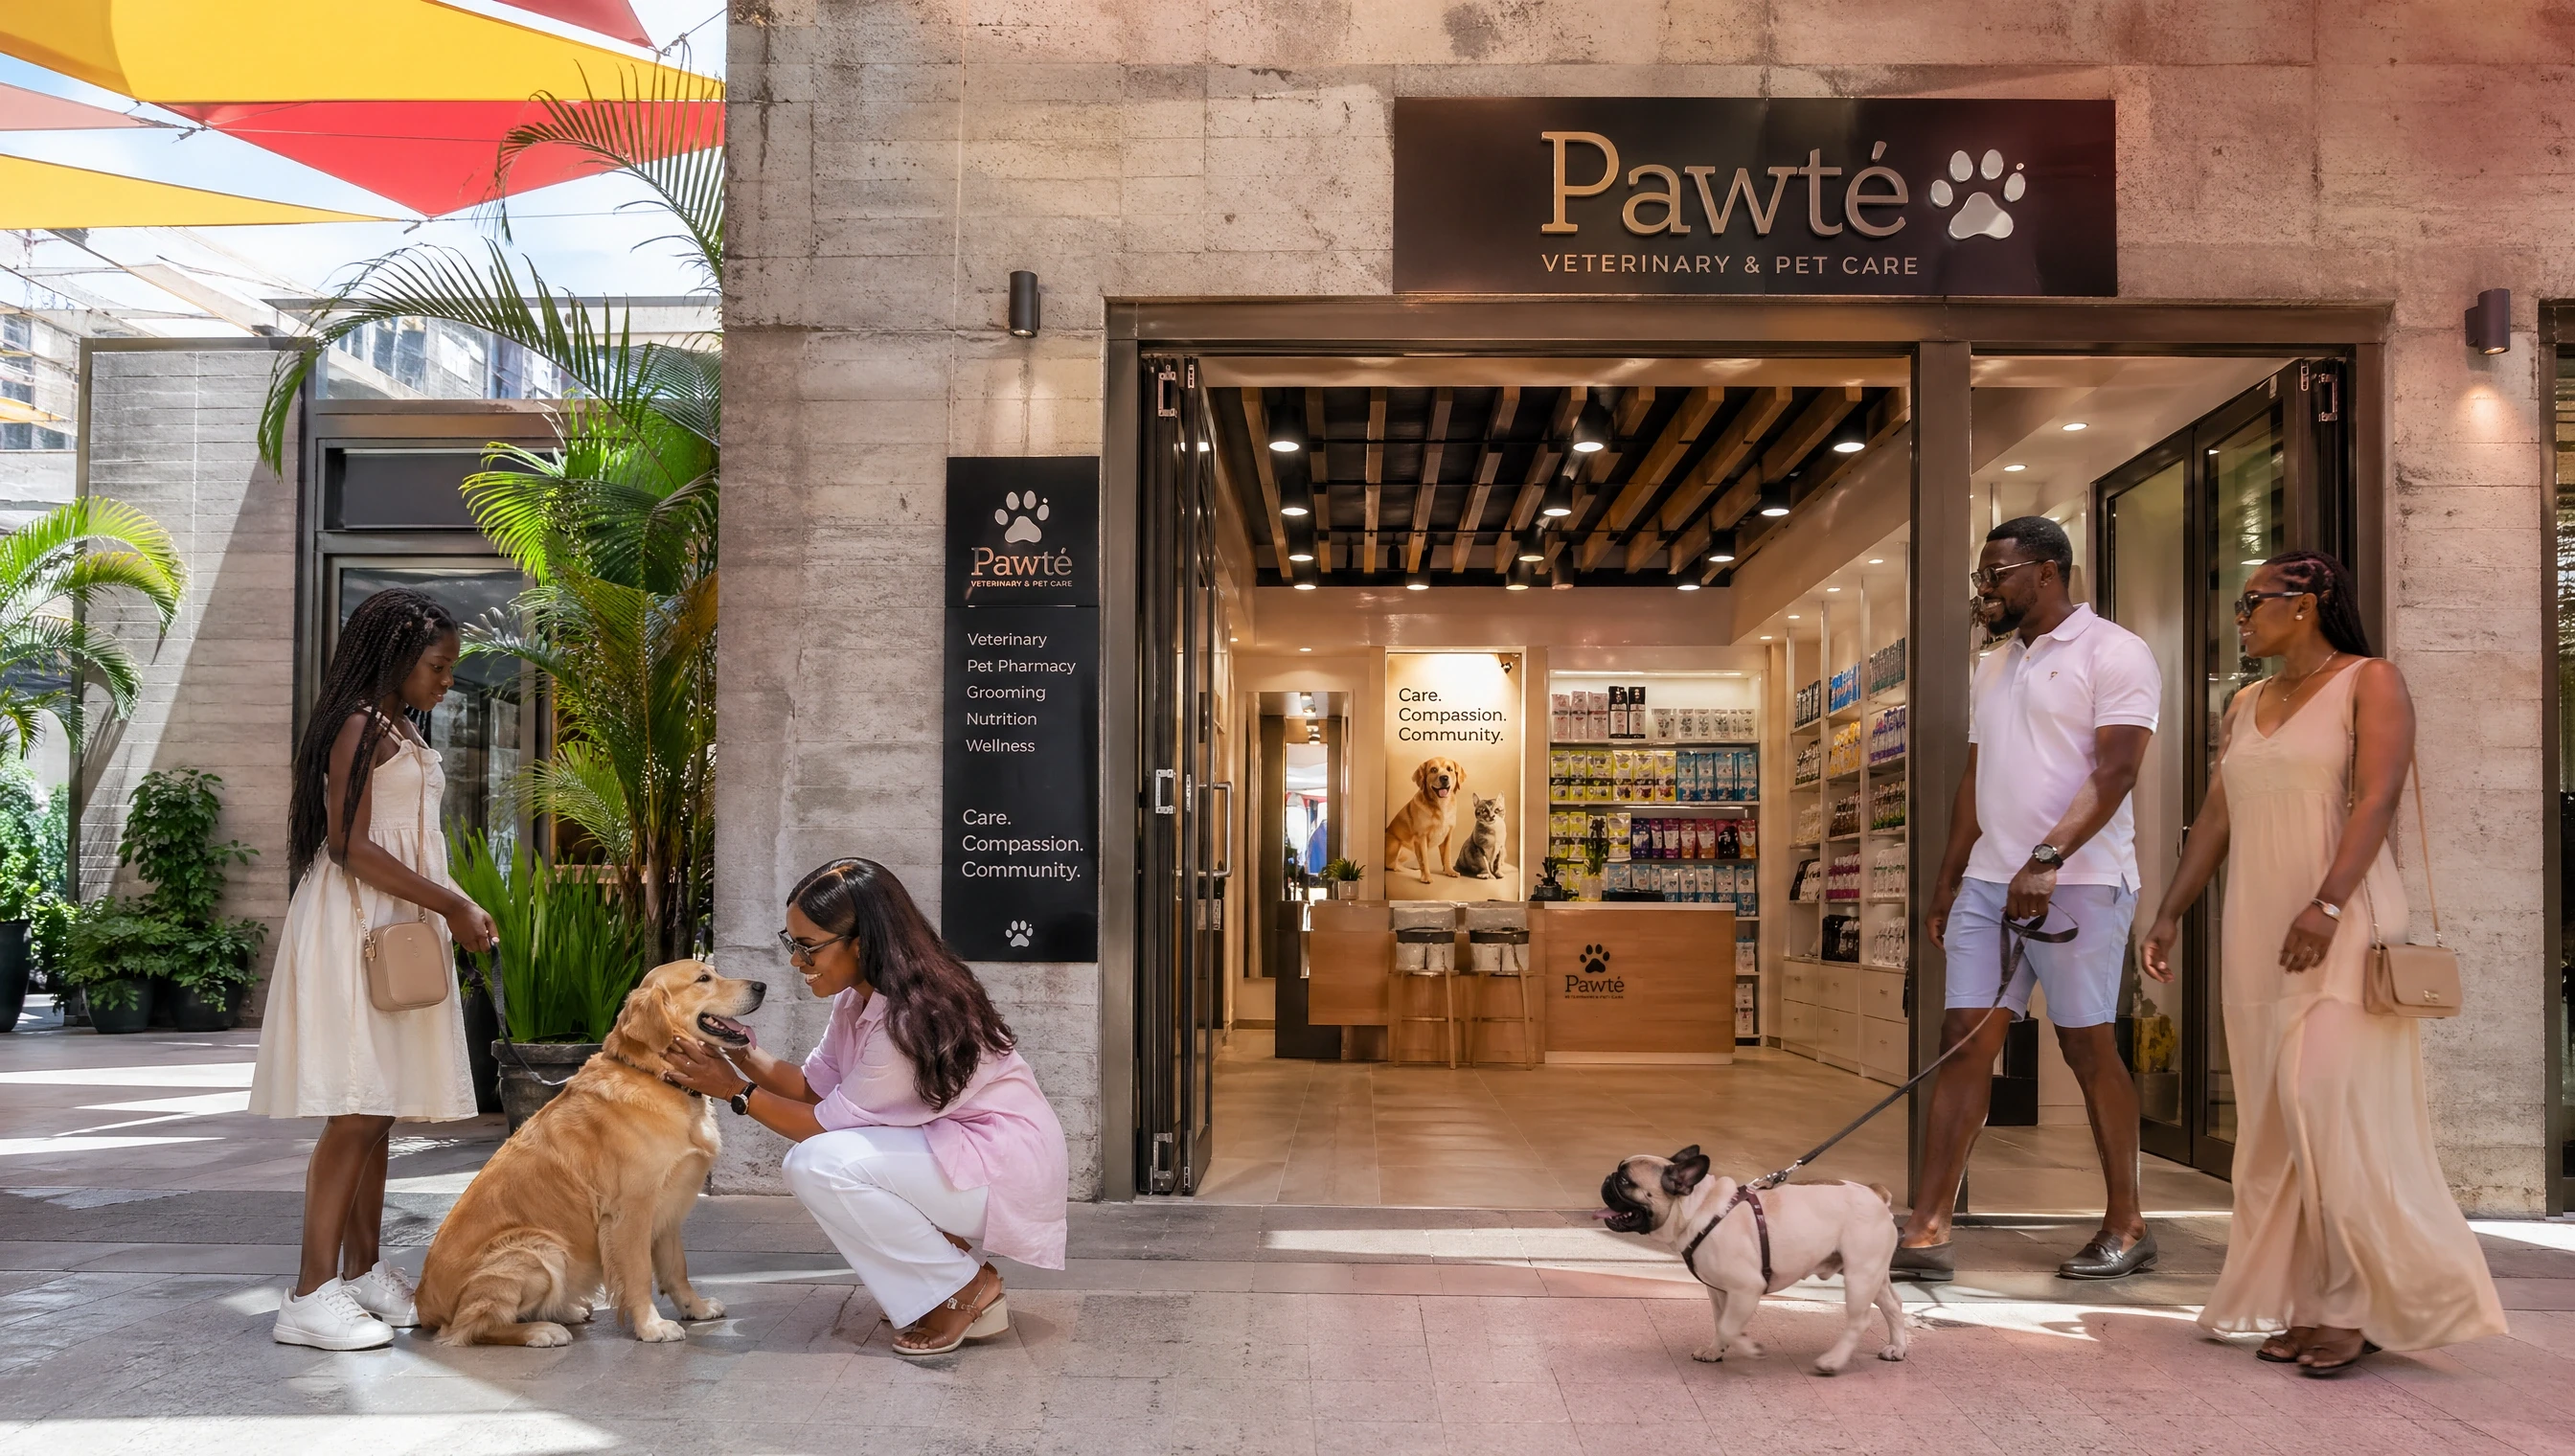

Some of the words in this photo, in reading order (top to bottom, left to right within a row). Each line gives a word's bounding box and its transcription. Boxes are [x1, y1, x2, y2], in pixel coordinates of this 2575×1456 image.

[1540, 130, 1910, 238] Pawté
[1540, 253, 1730, 275] VETERINARY
[1743, 255, 1761, 275] &
[1776, 256, 1828, 276] PET
[1842, 256, 1919, 276] CARE
[970, 546, 1073, 577] Pawté
[970, 580, 1022, 588] VETERINARY
[967, 632, 1048, 648] Veterinary
[967, 659, 993, 672] Pet
[998, 658, 1077, 675] Pharmacy
[967, 685, 1046, 702] Grooming
[1399, 687, 1442, 702] Care.
[967, 712, 1037, 726] Nutrition
[1399, 707, 1507, 725] Compassion.
[1399, 727, 1504, 745] Community.
[966, 738, 1036, 753] Wellness
[963, 808, 1012, 826] Care.
[962, 835, 1084, 855] Compassion.
[962, 861, 1082, 882] Community.
[1564, 974, 1625, 992] Pawté
